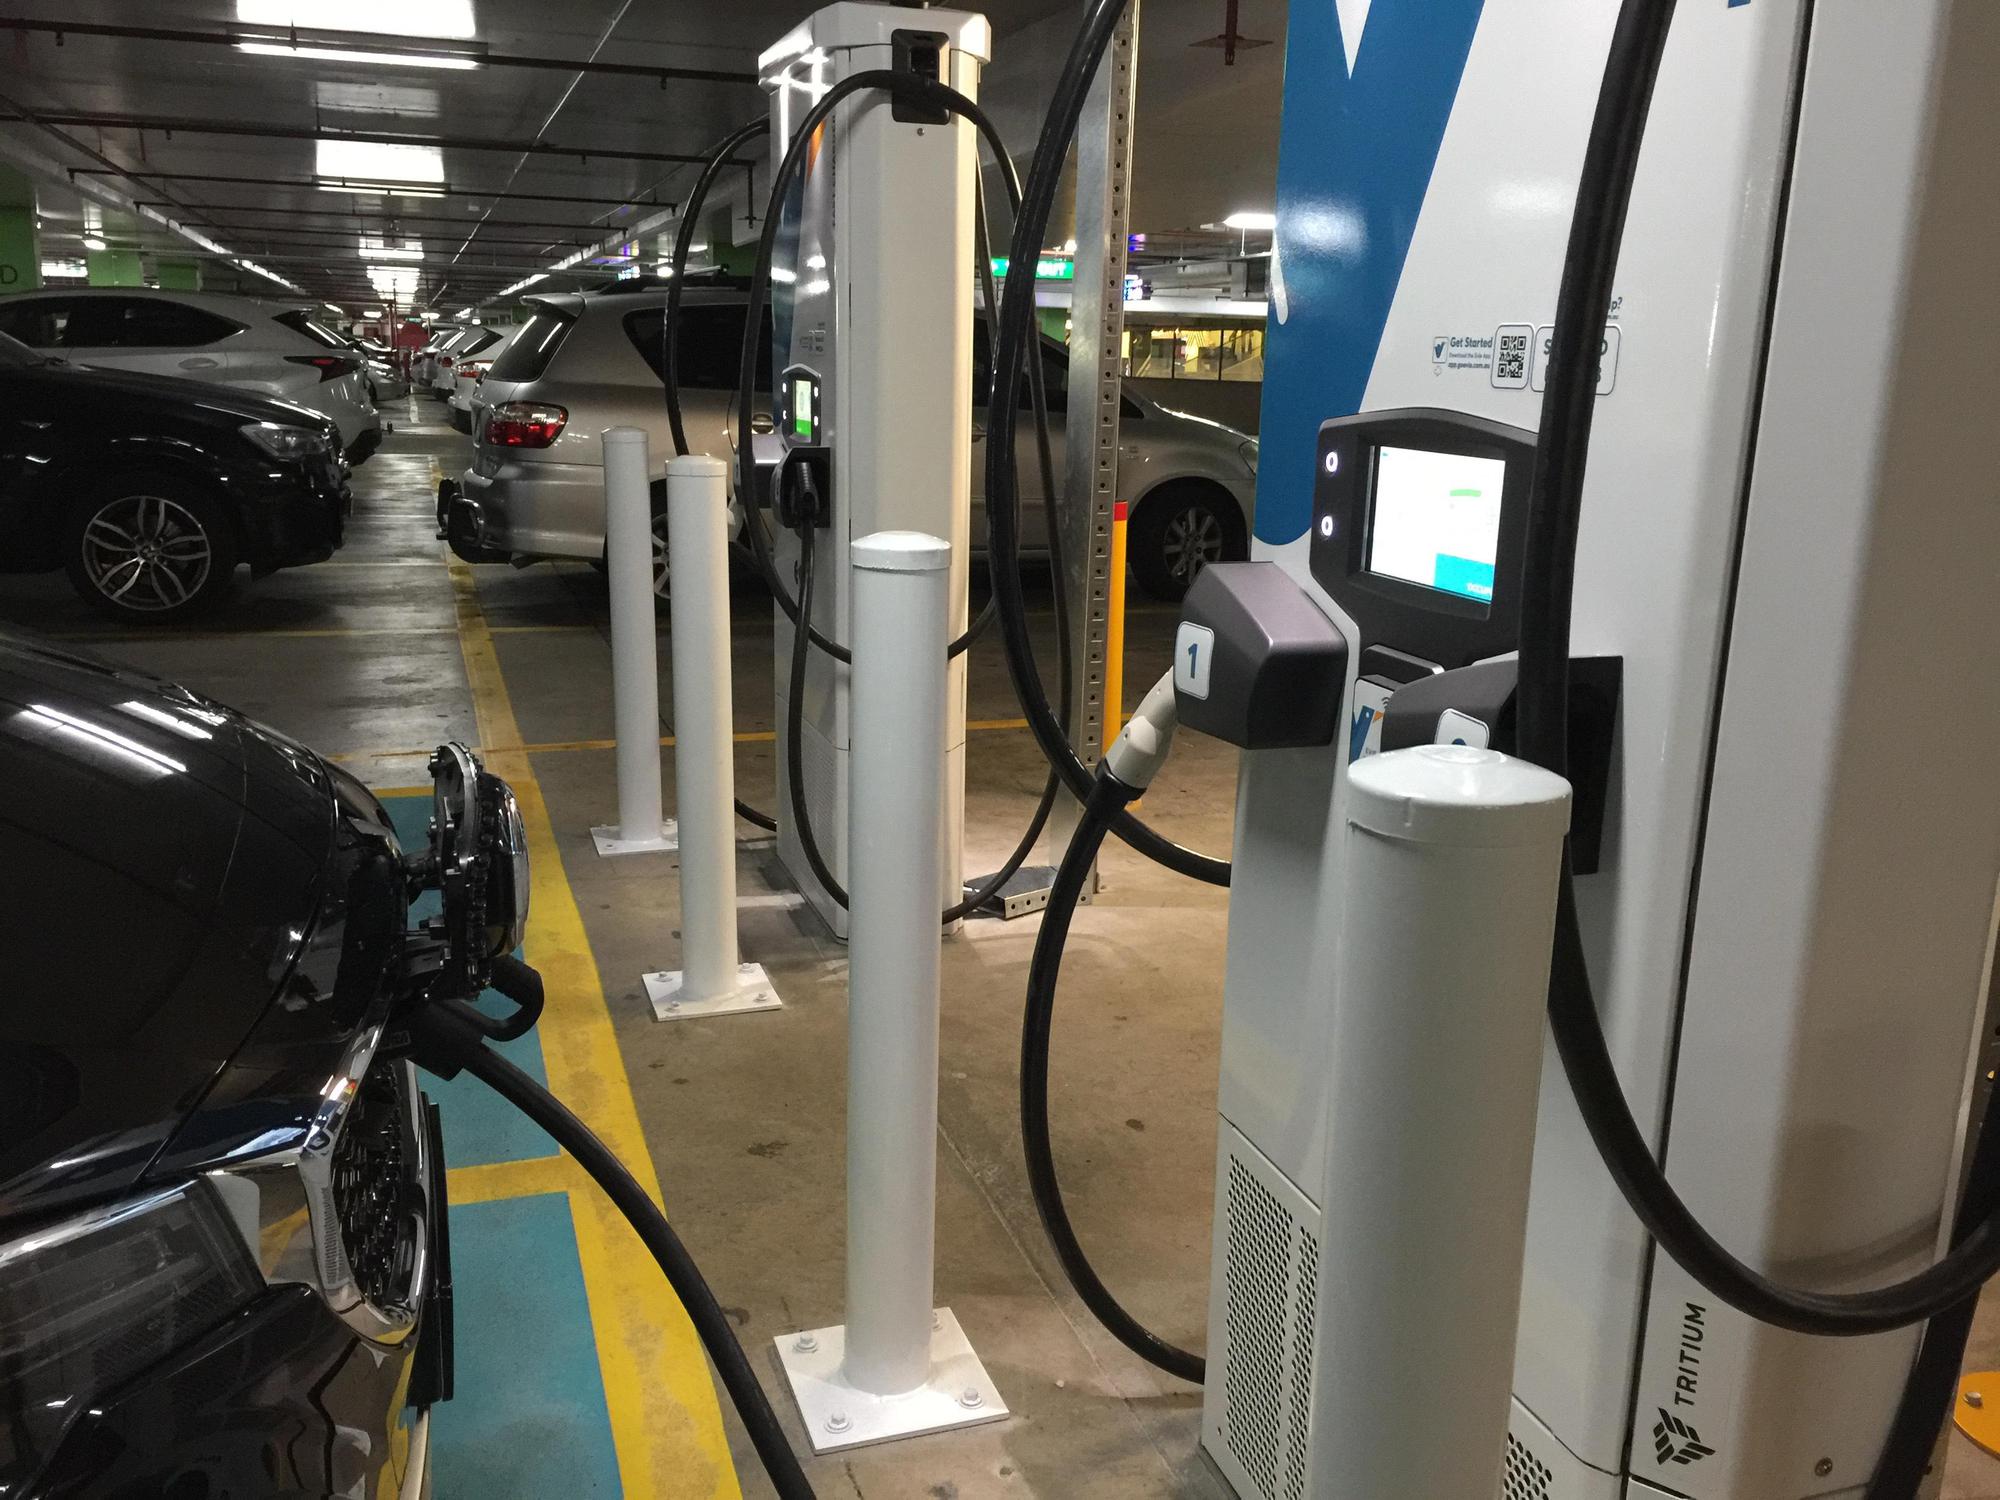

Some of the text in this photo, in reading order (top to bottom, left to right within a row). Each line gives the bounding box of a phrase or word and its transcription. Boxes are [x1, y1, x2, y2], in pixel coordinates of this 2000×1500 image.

[1450, 336, 1493, 348] Get Started
[1188, 643, 1198, 679] 1
[1674, 1302, 1706, 1406] TRITIUM
